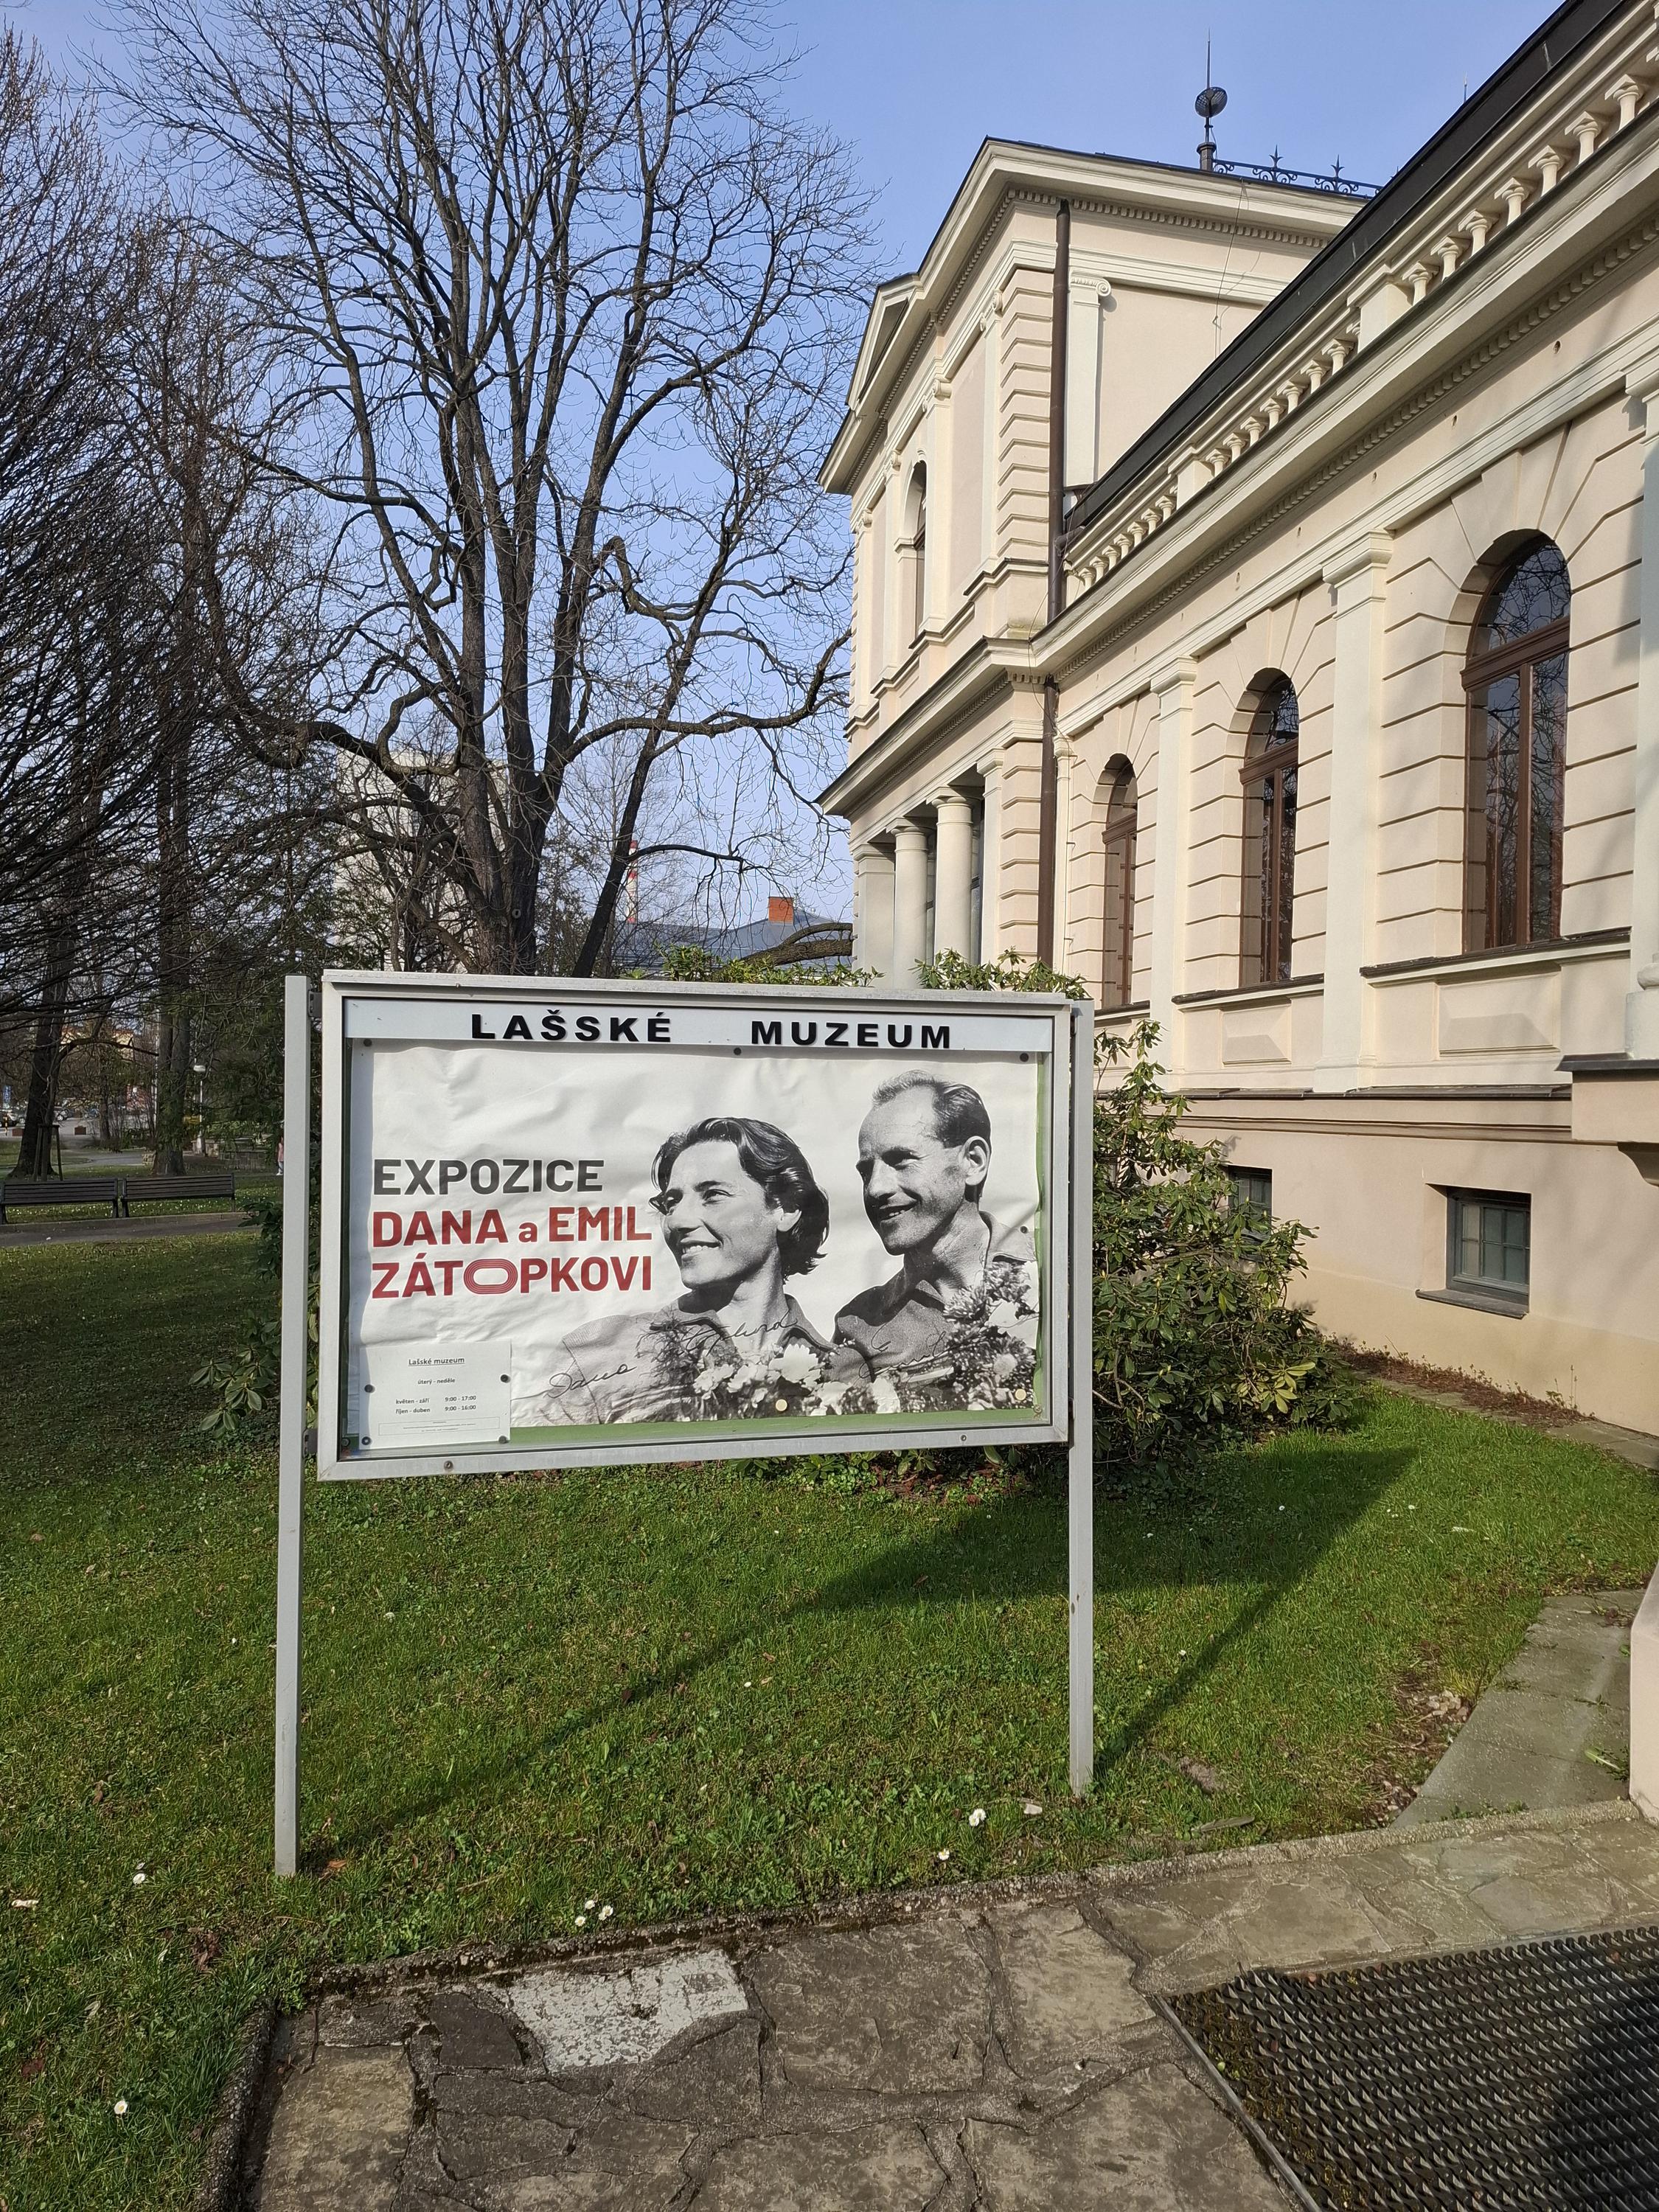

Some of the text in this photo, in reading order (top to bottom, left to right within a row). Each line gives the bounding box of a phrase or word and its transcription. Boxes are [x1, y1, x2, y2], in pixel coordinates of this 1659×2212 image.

[470, 1009, 950, 1049] LAŠSKÉ MUZEUM
[373, 1158, 605, 1195] EXPOZICE
[372, 1206, 653, 1248] DANA a EMIL
[372, 1252, 652, 1299] ZÁTOPKOVI
[408, 1357, 432, 1366] Lašské
